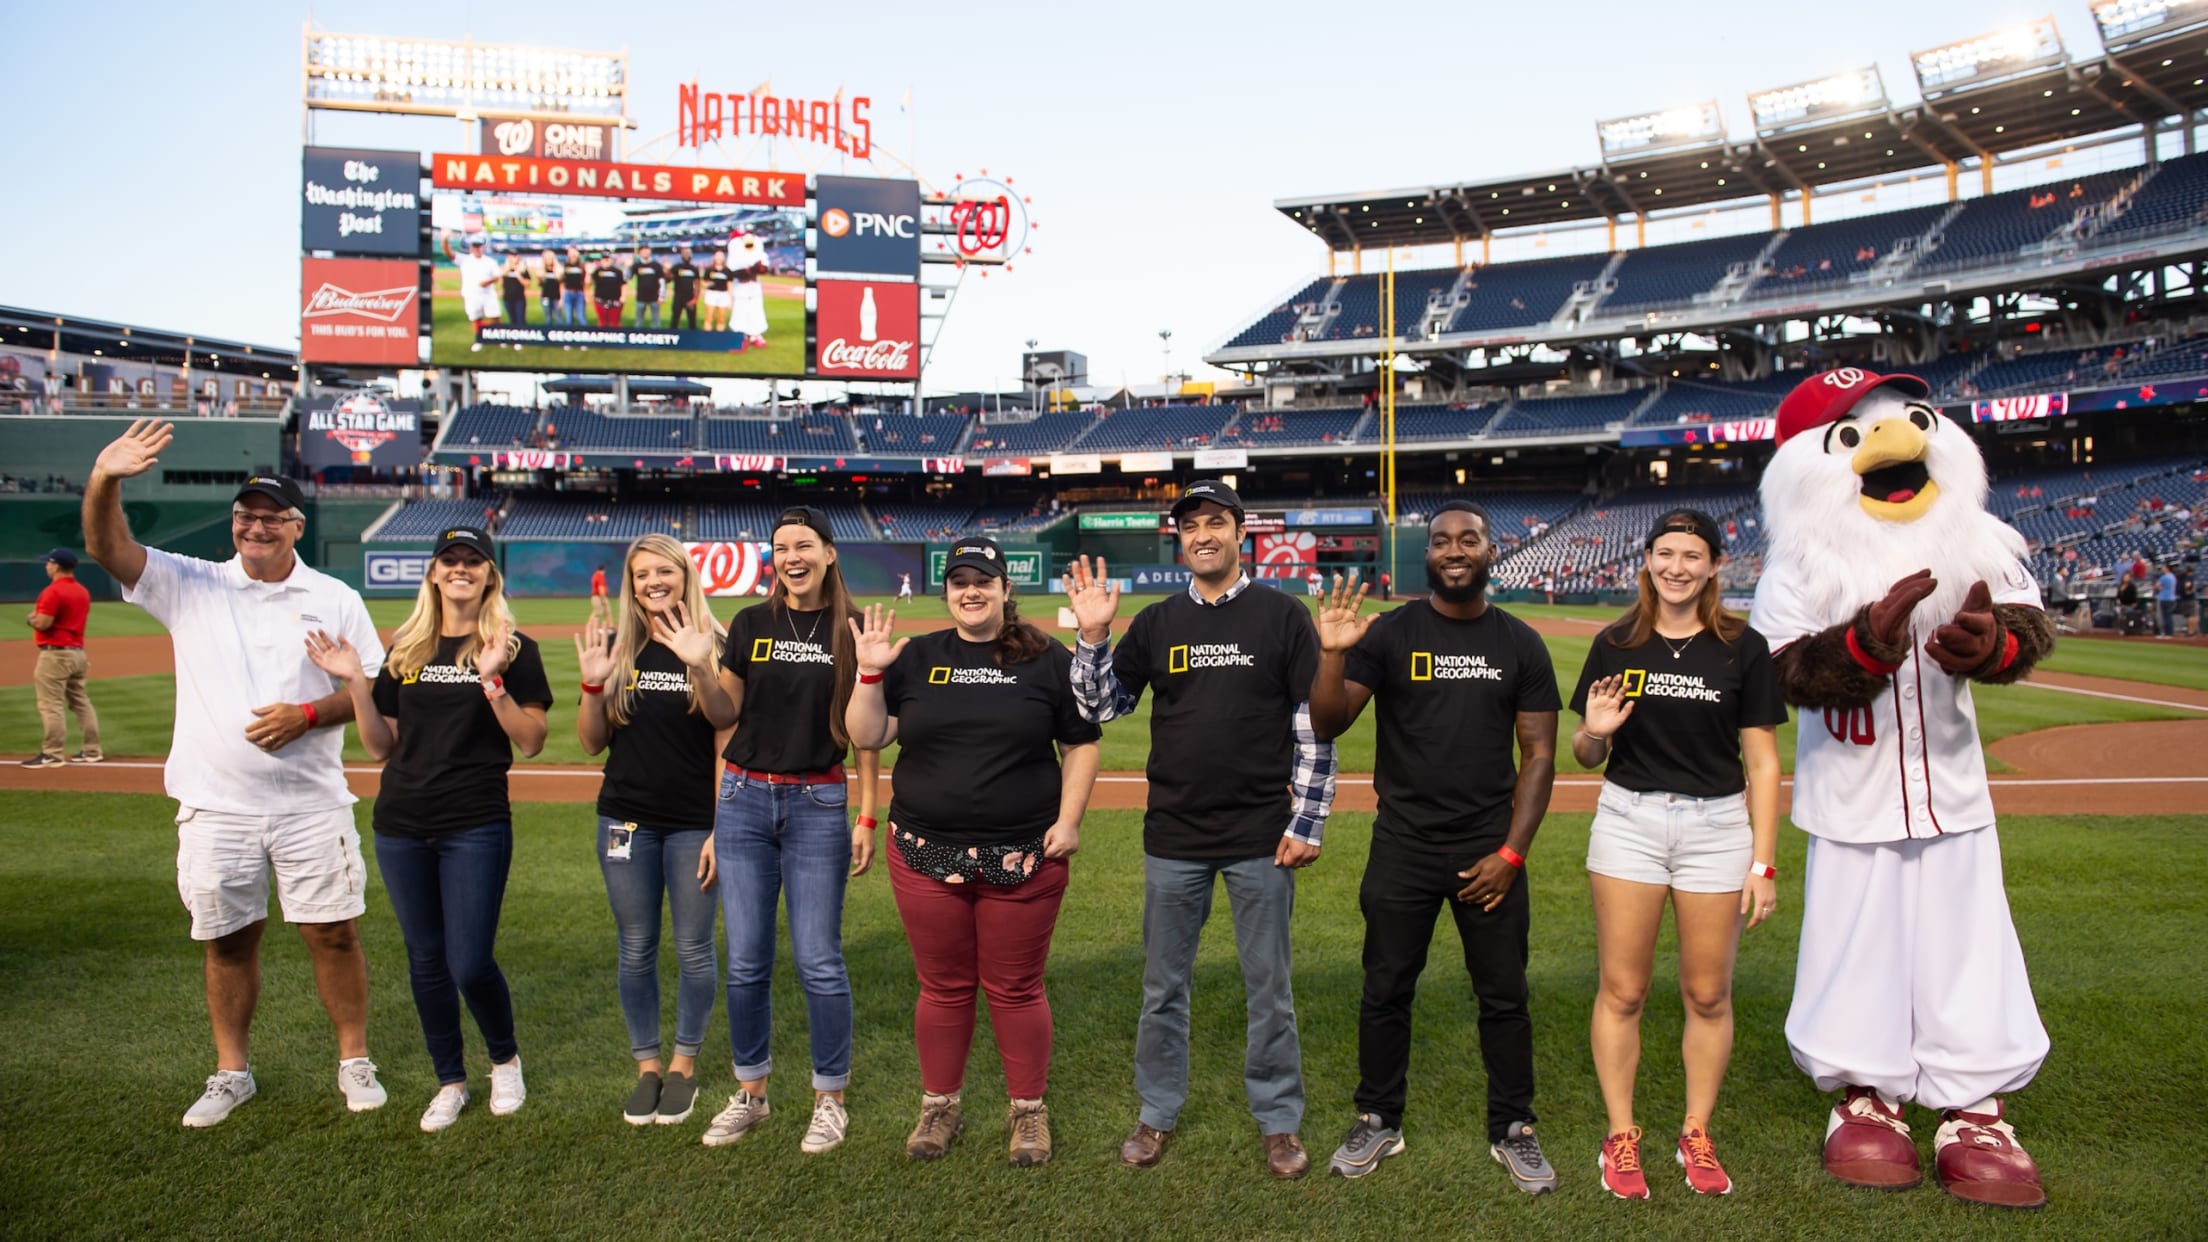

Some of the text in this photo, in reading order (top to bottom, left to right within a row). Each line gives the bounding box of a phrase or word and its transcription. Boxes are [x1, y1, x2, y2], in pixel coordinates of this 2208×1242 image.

[679, 82, 871, 159] NATIONALS
[545, 123, 602, 146] ONE
[544, 142, 601, 160] PURSUIT
[343, 160, 380, 183] The
[446, 160, 787, 198] NATIONALS PARK
[305, 180, 416, 212] Washington
[338, 212, 383, 238] Post
[853, 212, 915, 238] PNC
[312, 289, 404, 310] Budweiser
[311, 324, 334, 336] THIS
[365, 326, 385, 338] FOR
[482, 328, 680, 346] NATIONAL GEOGRAPHIC SOCIETY
[308, 411, 416, 431] ALL STAR GAME
[1152, 571, 1193, 583] DELT
[774, 640, 823, 654] NATIONAL
[1190, 643, 1240, 656] NATIONAL
[772, 650, 834, 665] GEOGRAPHIC
[1189, 655, 1255, 668] GEOGRAPHIC
[1434, 655, 1488, 667] NATIONAL
[420, 672, 481, 683] GEOGRAPHIC
[640, 671, 685, 682] NATIONAL
[950, 675, 1017, 684] GEOGRAPHIC
[953, 667, 1004, 677] NATIONAL
[1434, 667, 1502, 680] GEOGRAPHIC
[1647, 673, 1706, 688] NATIONAL
[1644, 684, 1721, 702] GEOGRAPHIC
